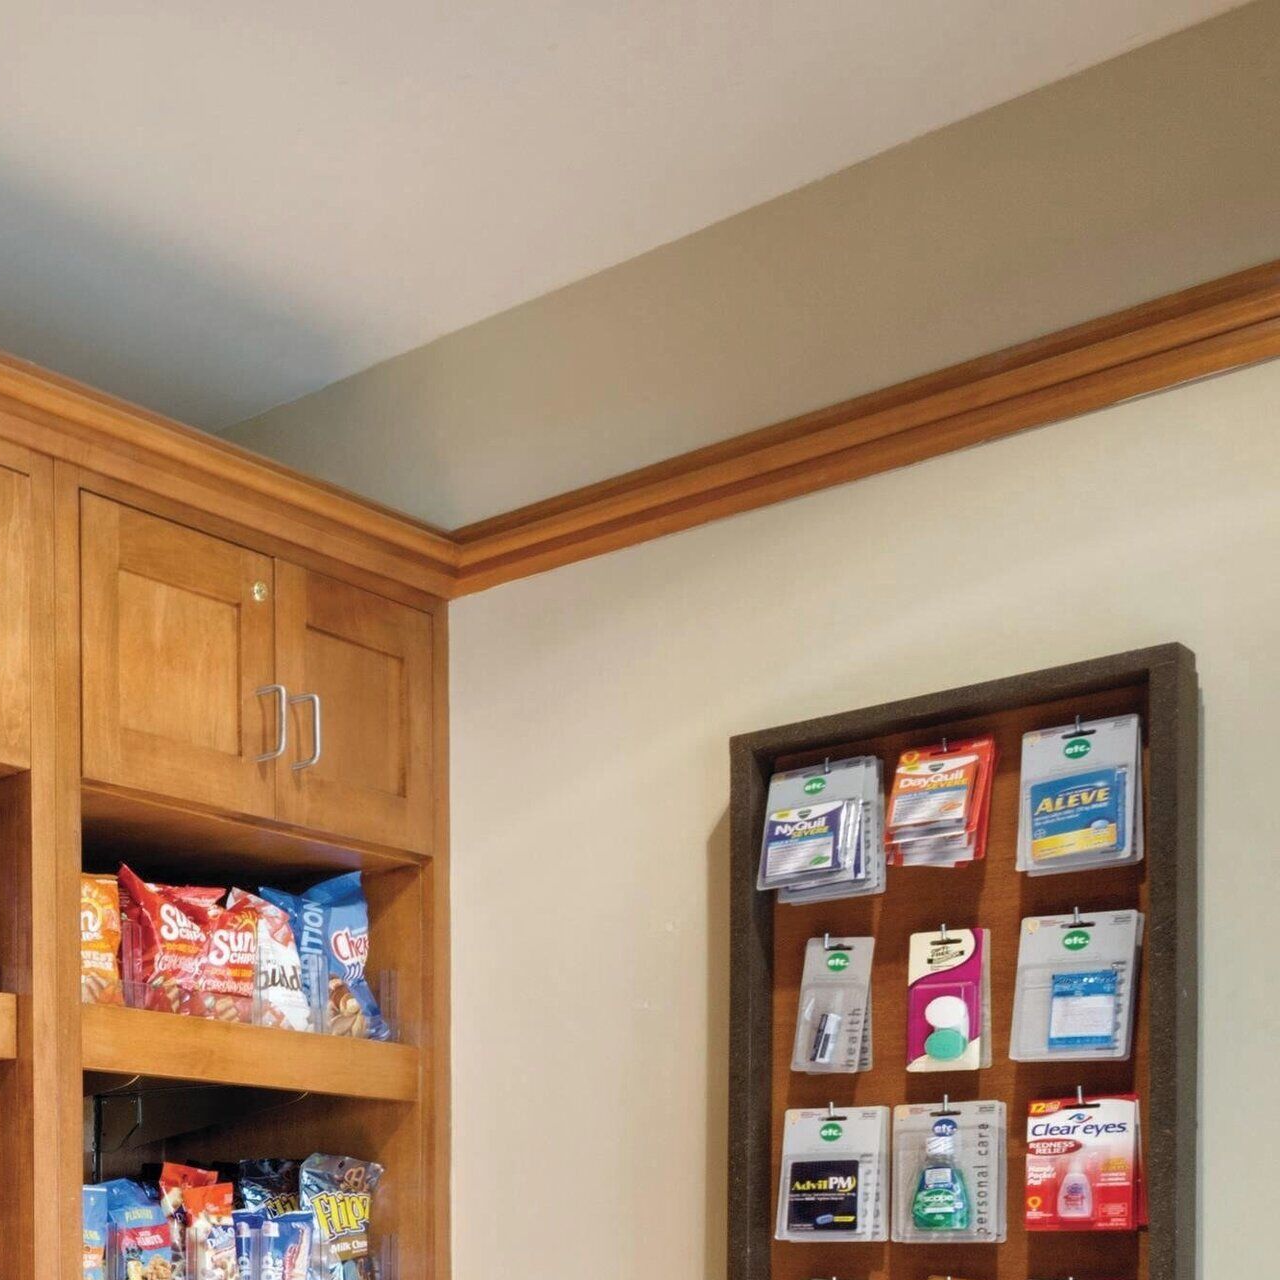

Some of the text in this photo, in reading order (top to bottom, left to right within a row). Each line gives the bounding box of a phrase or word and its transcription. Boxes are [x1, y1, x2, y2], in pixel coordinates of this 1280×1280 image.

[1064, 744, 1091, 756] etc.
[899, 769, 964, 790] DayQuil
[804, 781, 827, 793] etc.
[1035, 786, 1111, 816] ALEVE
[774, 816, 827, 839] NyQuil
[1063, 935, 1090, 946] etc.
[210, 929, 257, 967] Sun
[827, 957, 850, 968] etc.
[820, 1127, 843, 1138] etc.
[933, 1124, 958, 1135] etc.
[1031, 1121, 1127, 1137] Clear eyes
[1028, 1141, 1075, 1151] REDNESS
[1035, 1148, 1067, 1157] RELIEF
[792, 1177, 828, 1193] Advil
